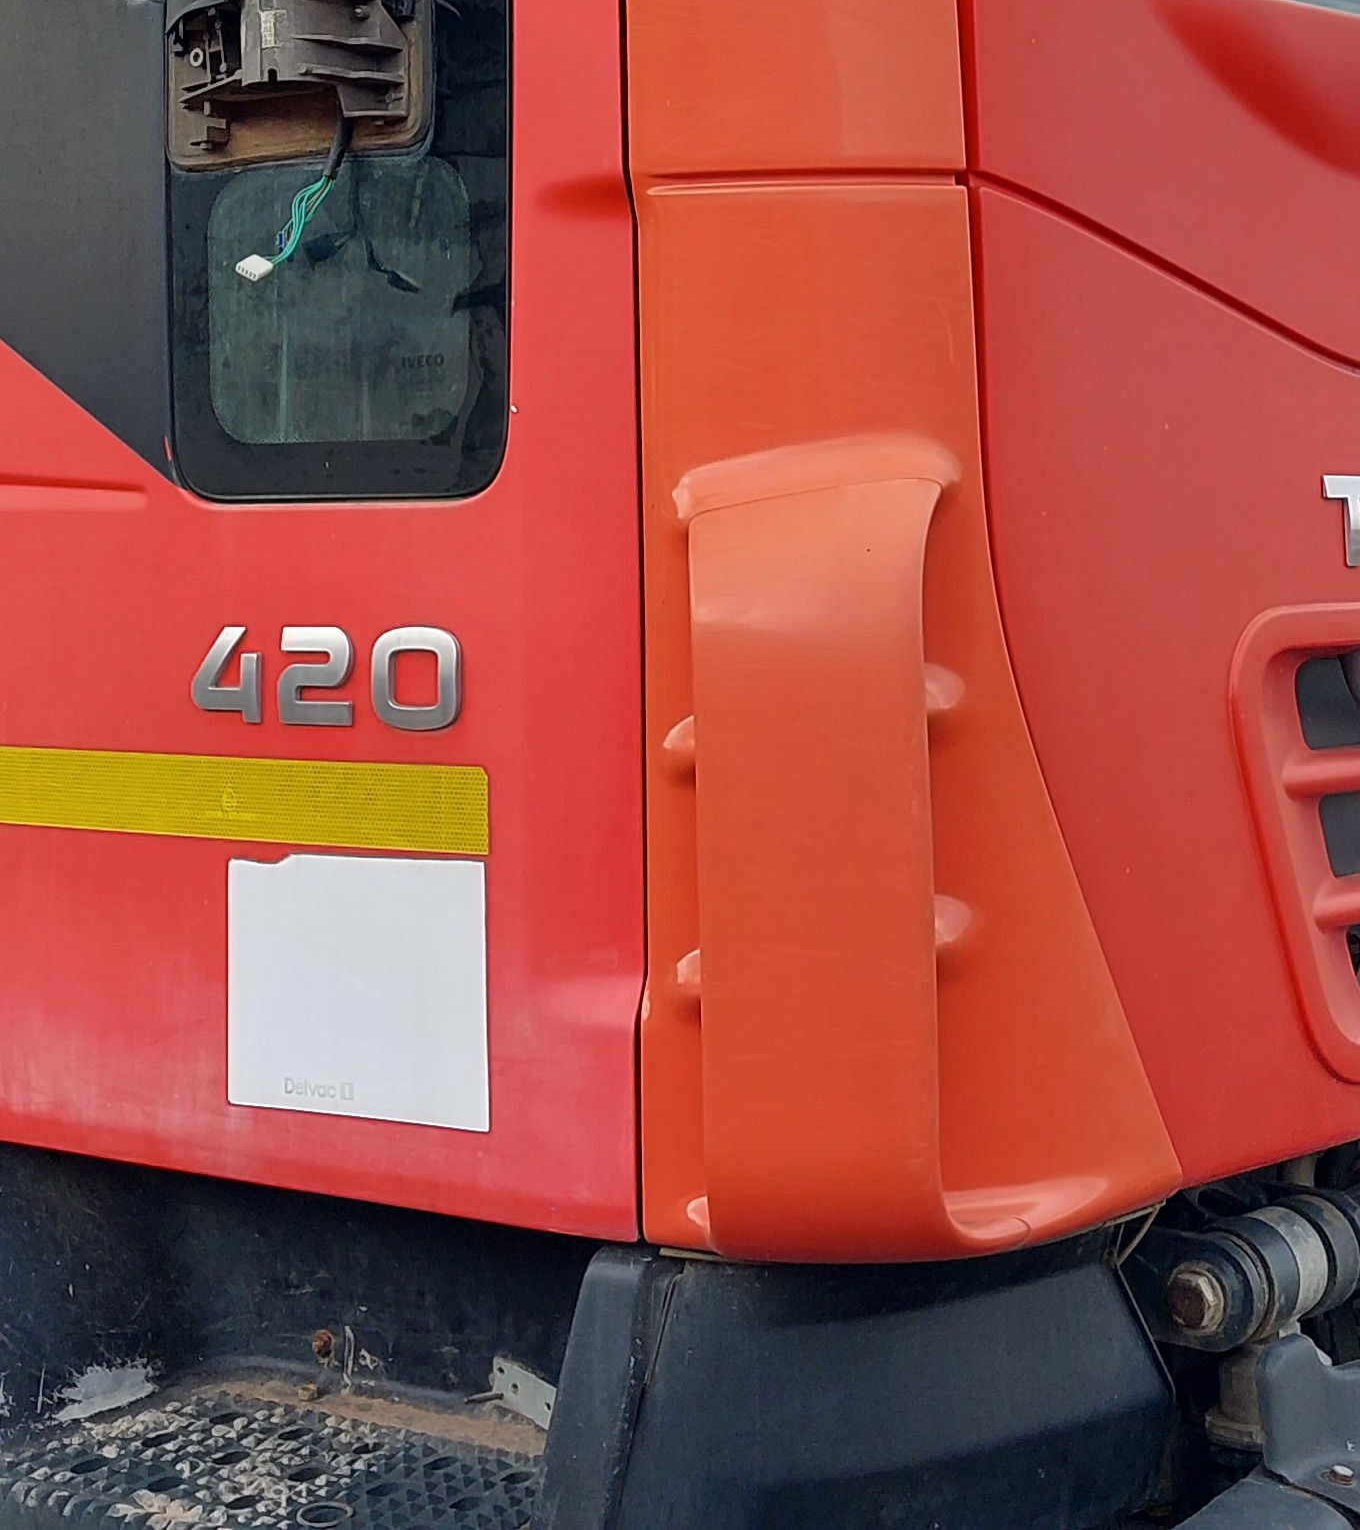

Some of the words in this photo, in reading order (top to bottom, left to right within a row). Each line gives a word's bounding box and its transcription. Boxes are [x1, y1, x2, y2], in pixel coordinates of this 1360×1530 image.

[401, 353, 445, 368] IVECO
[190, 625, 462, 732] 420
[284, 1076, 337, 1099] Delvac
